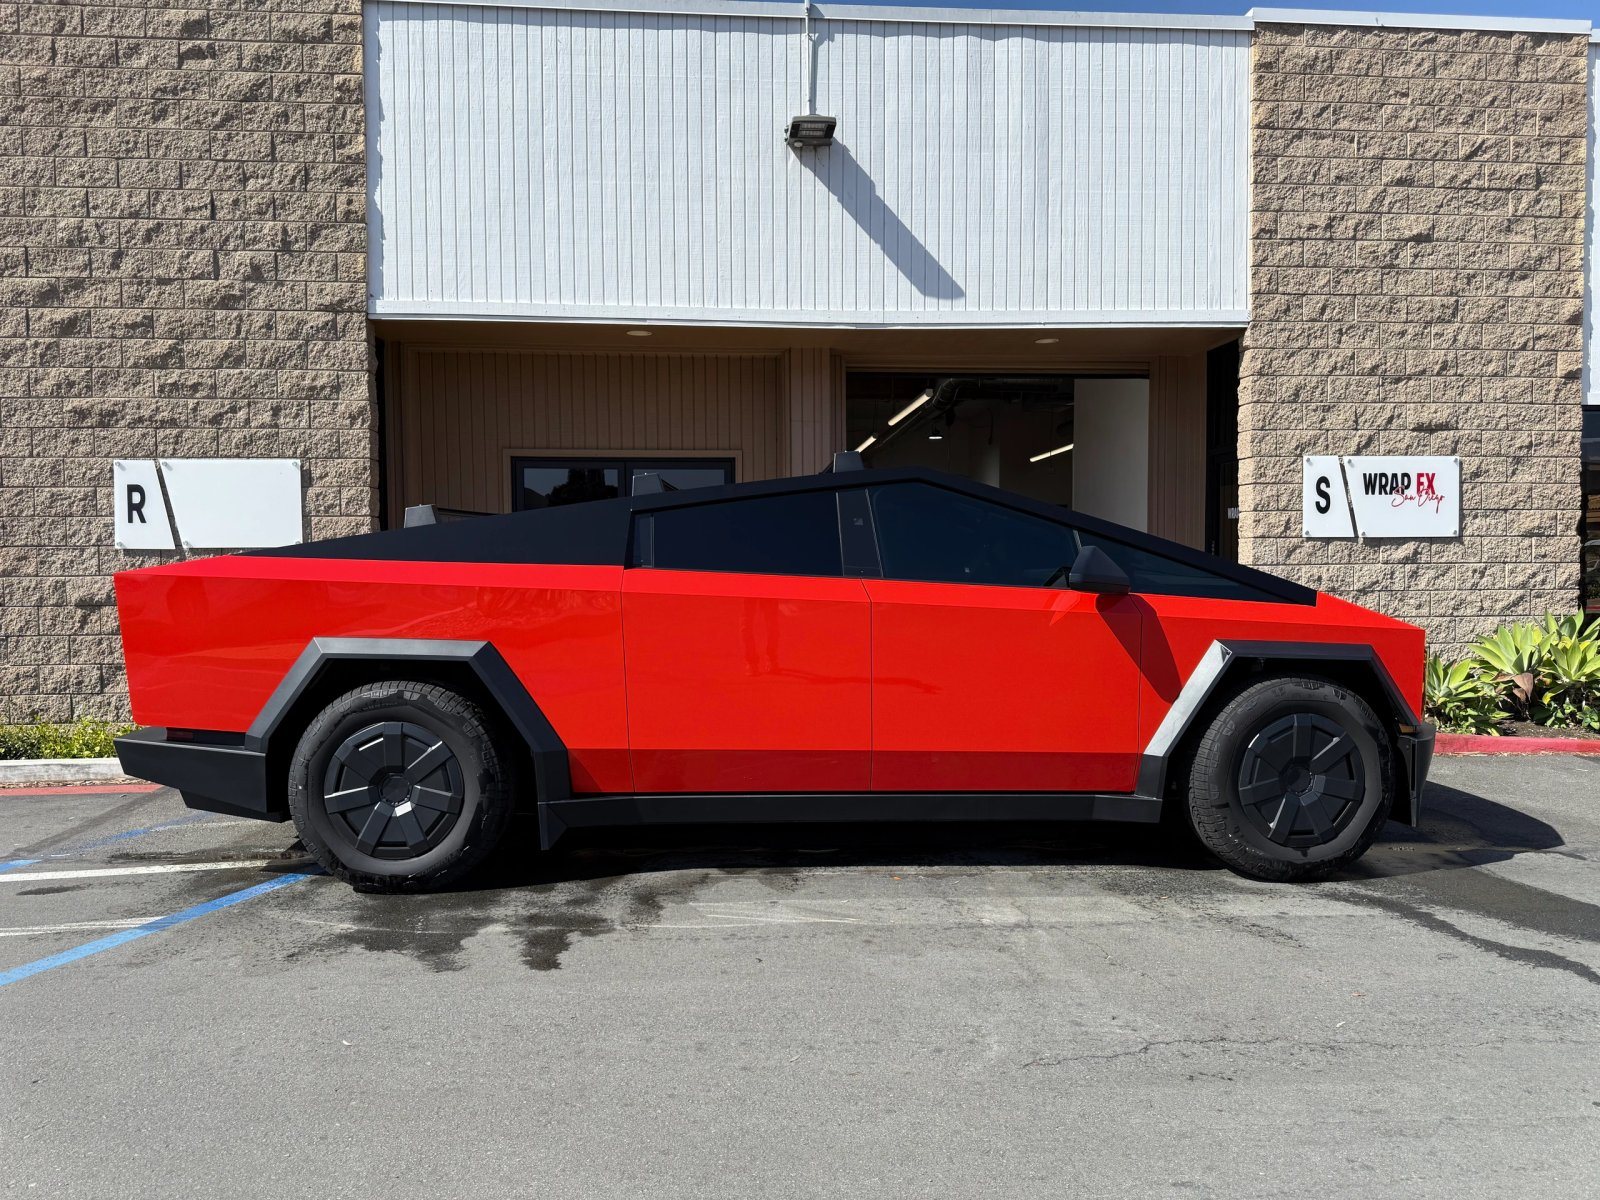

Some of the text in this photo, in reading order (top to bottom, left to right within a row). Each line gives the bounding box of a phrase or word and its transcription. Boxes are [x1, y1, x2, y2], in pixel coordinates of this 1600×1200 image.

[126, 484, 147, 524] R
[1315, 475, 1331, 515] S
[1362, 472, 1436, 496] WRAP FX
